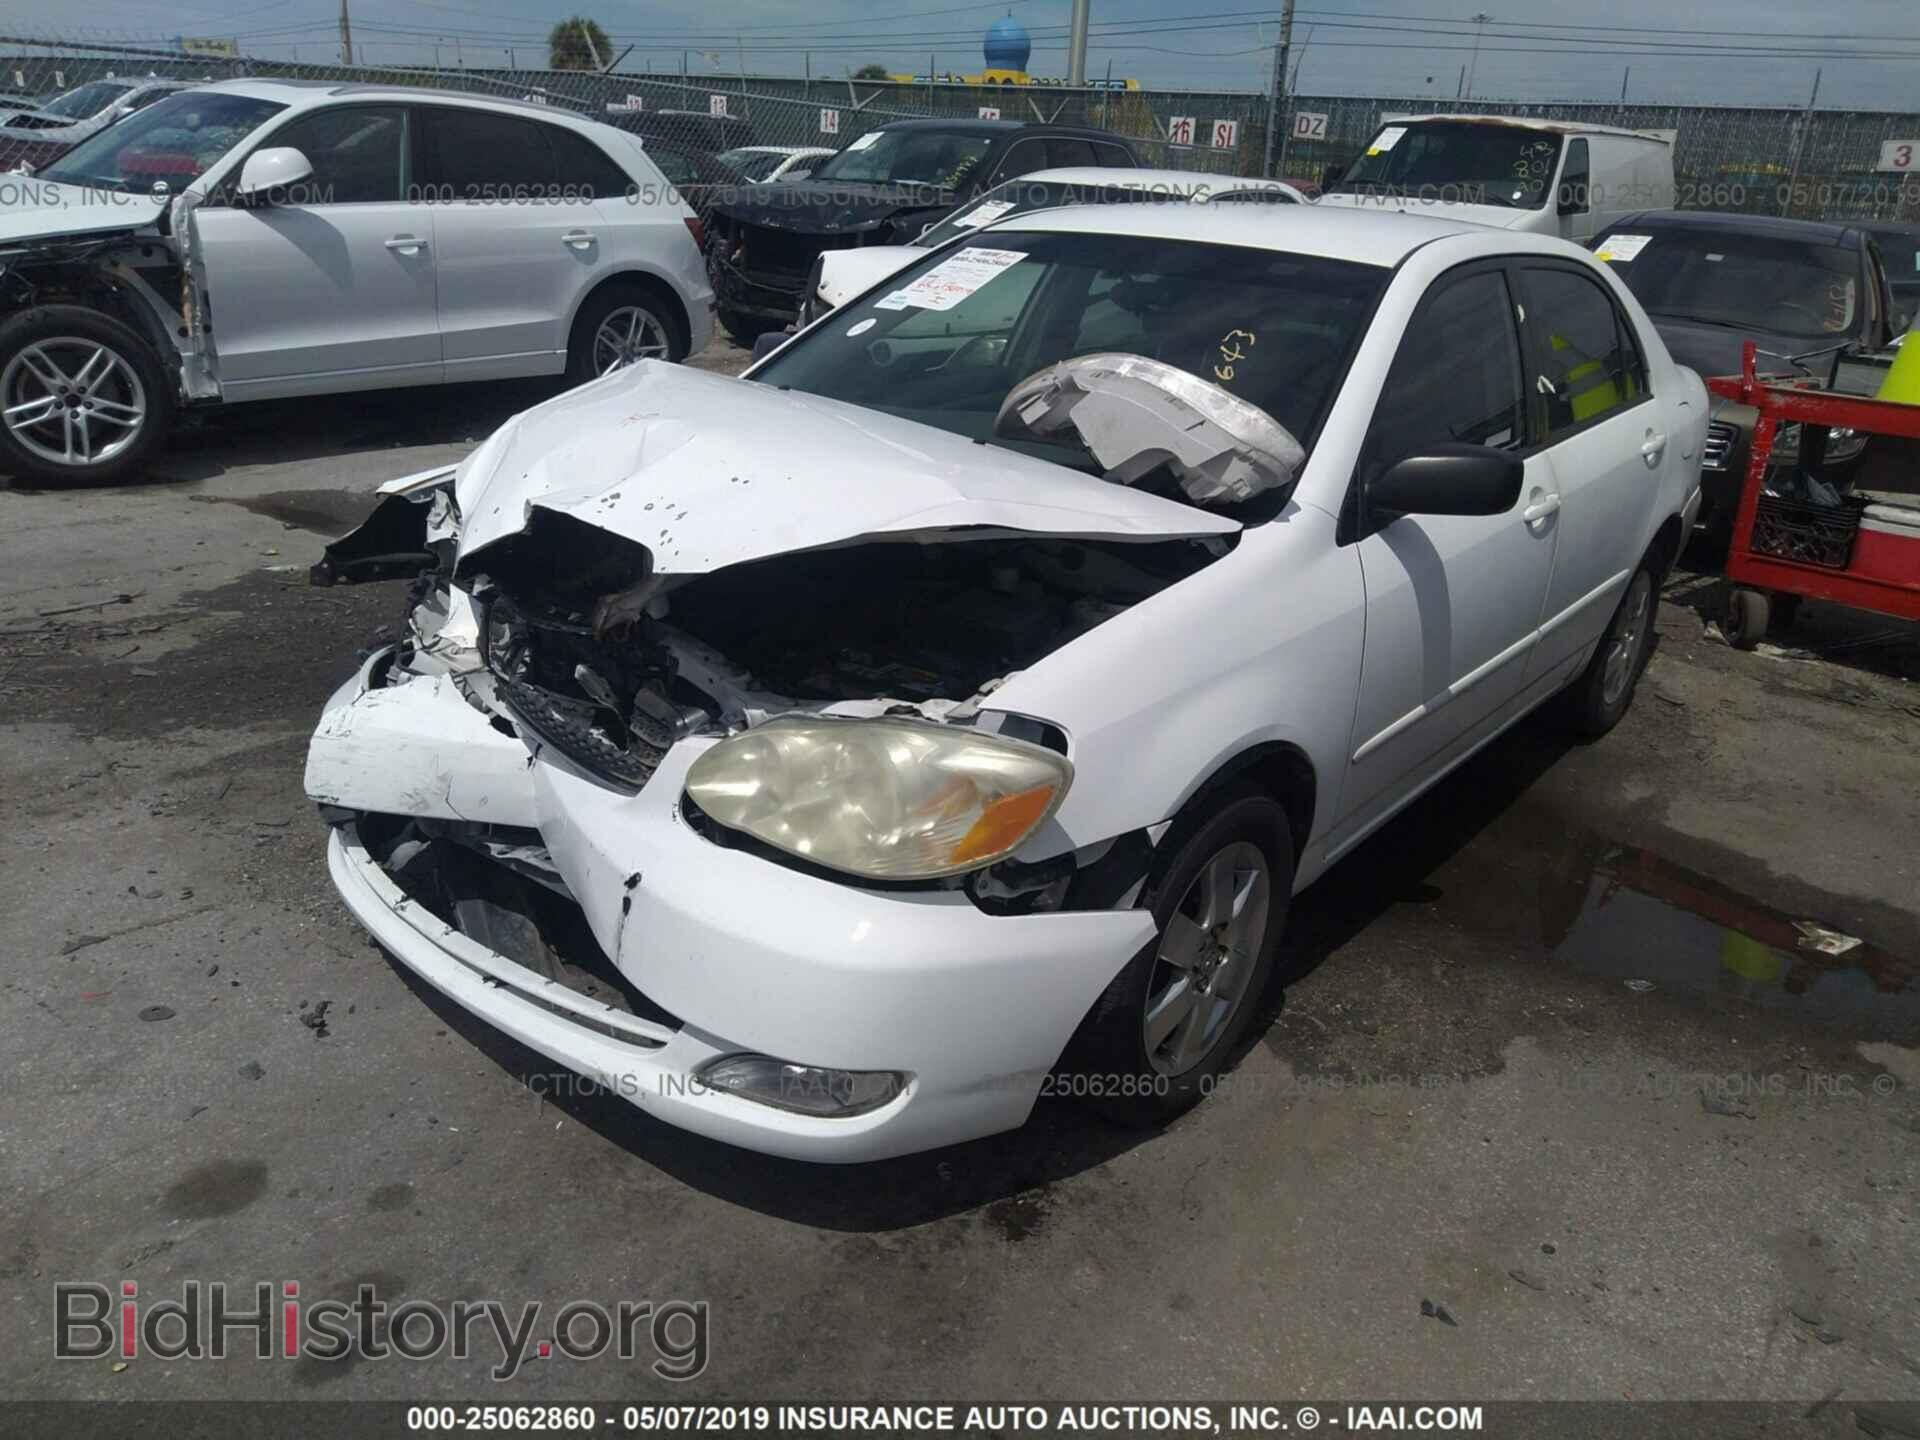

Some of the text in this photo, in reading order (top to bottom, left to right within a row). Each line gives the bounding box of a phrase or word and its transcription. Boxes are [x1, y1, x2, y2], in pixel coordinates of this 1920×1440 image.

[823, 111, 836, 129] 14
[1297, 115, 1322, 137] DZ
[1894, 144, 1912, 167] 3
